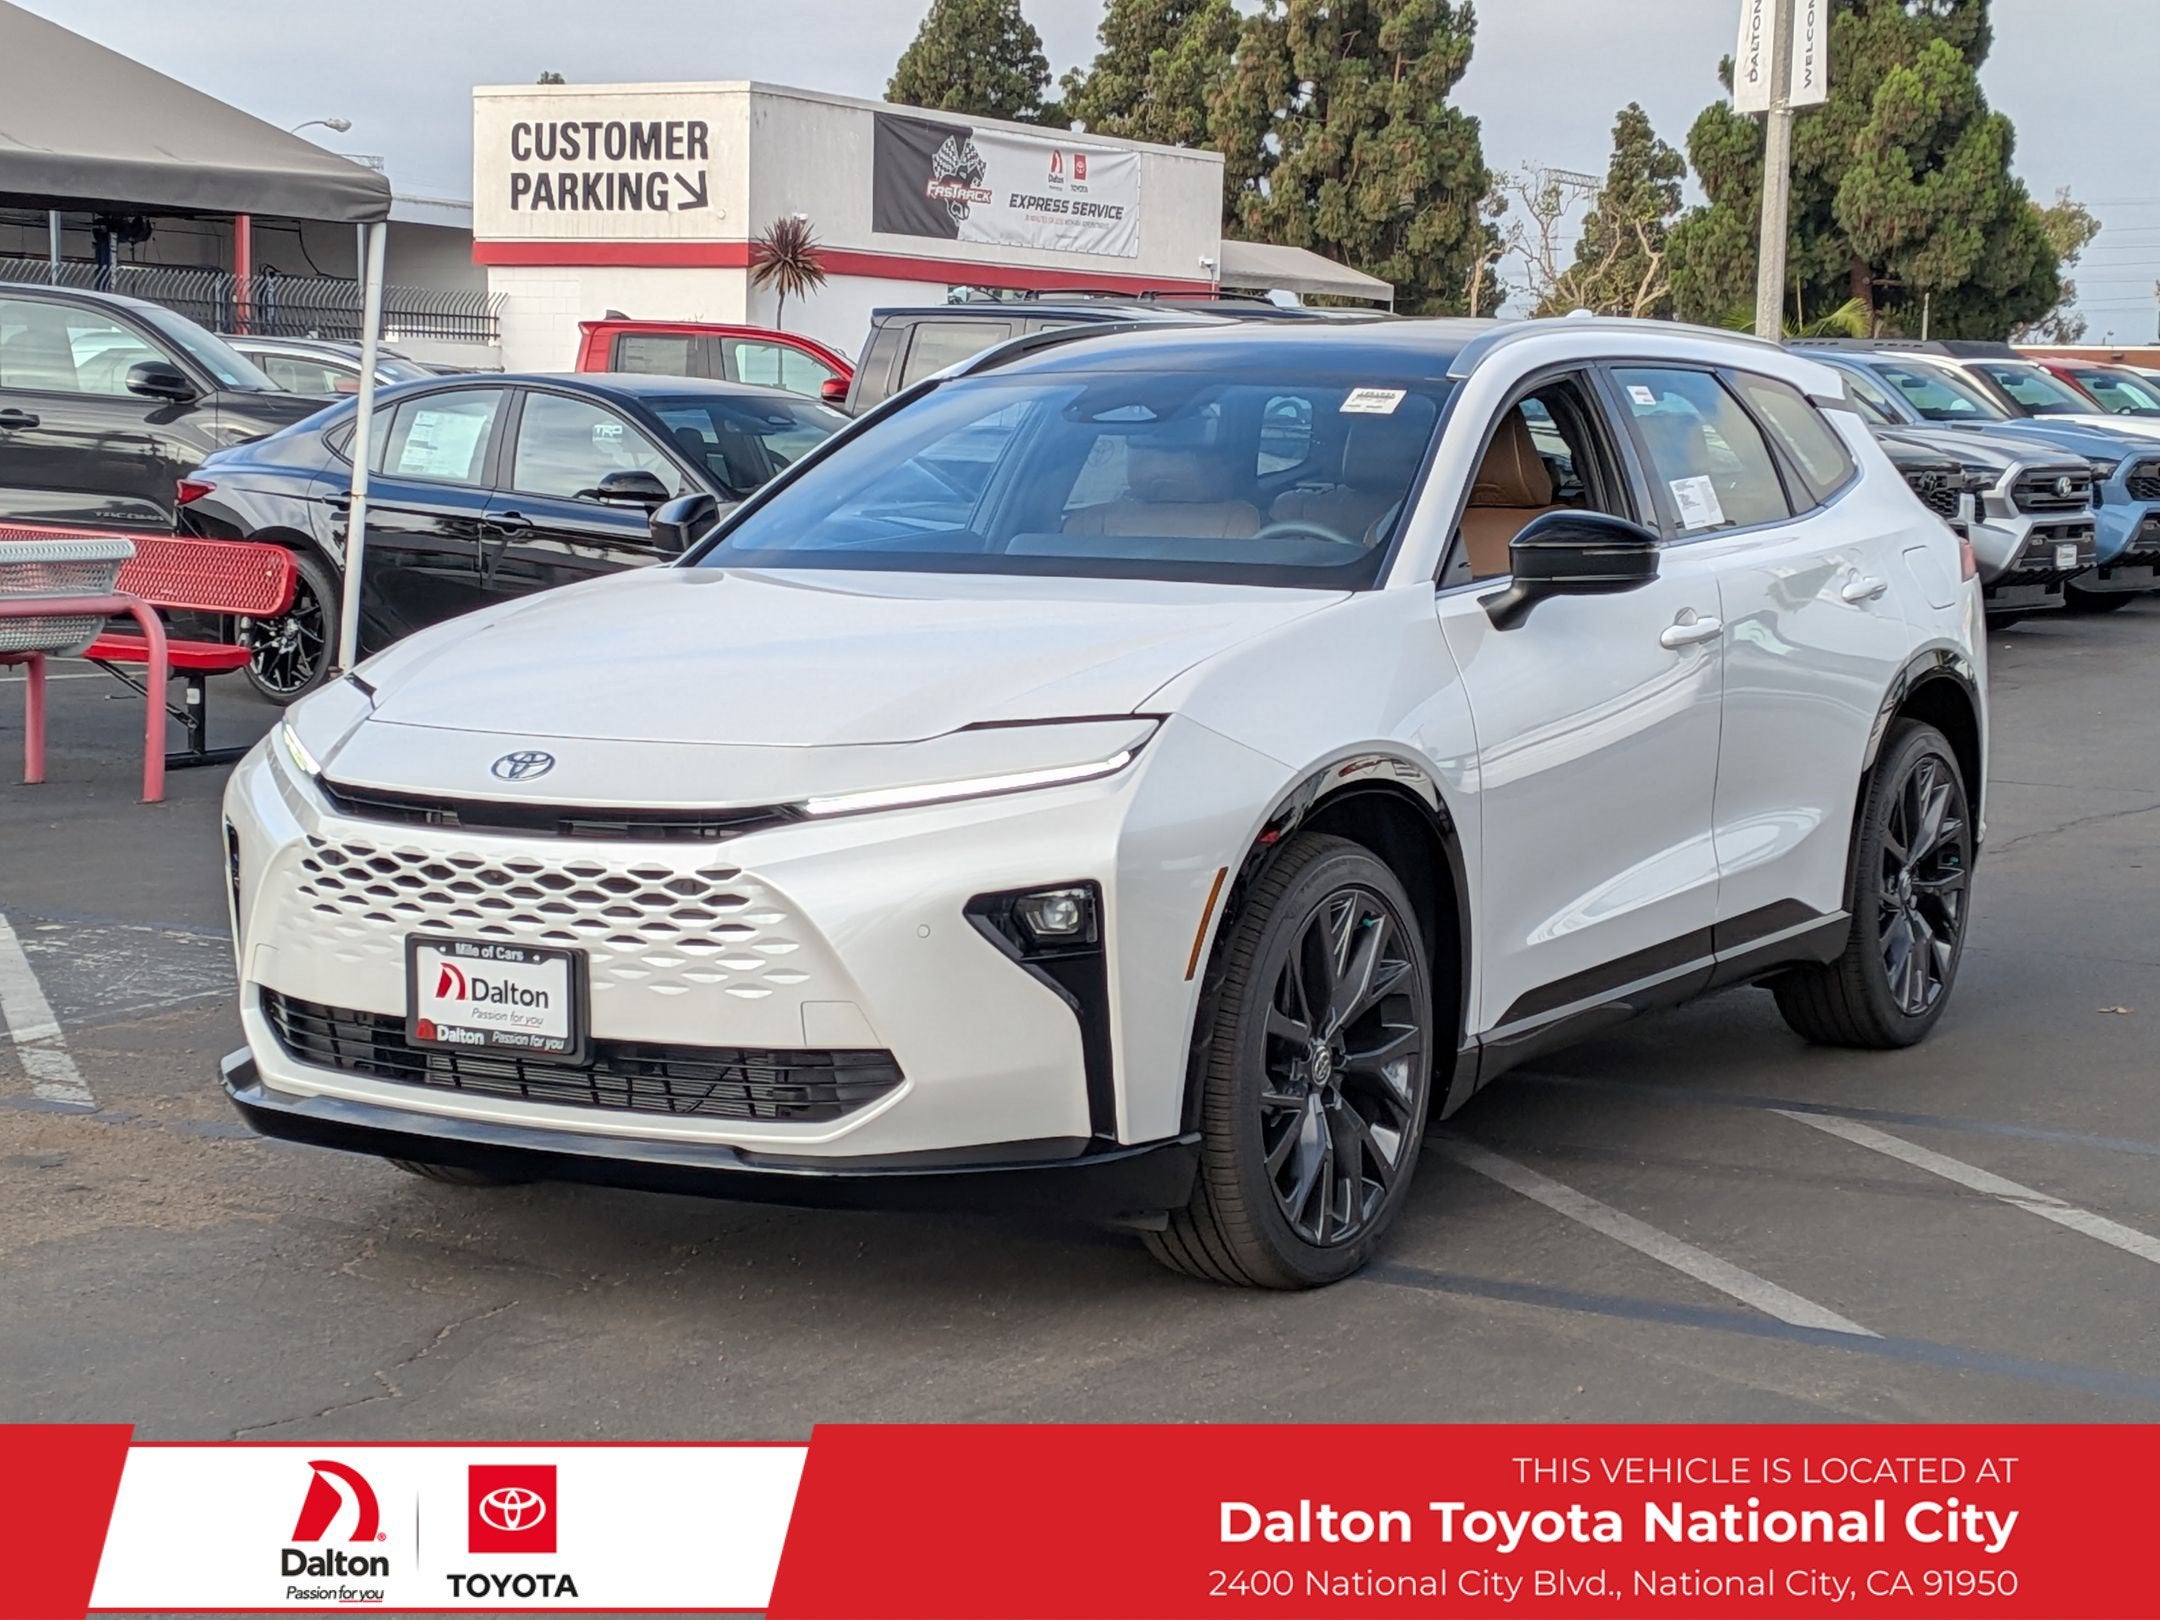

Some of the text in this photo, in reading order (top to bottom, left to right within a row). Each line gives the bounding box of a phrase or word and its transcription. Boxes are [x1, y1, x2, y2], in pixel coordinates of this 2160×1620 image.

[1749, 0, 1762, 83] DALTON
[510, 120, 709, 162] CUSTOMER
[510, 171, 669, 211] PARKING
[1009, 193, 1124, 220] EXPRESS SERVICE
[455, 943, 524, 961] Mile of Cars
[471, 977, 549, 1009] Dalton
[472, 1008, 544, 1026] Passion for you
[437, 1025, 564, 1051] Dalton Passion for you
